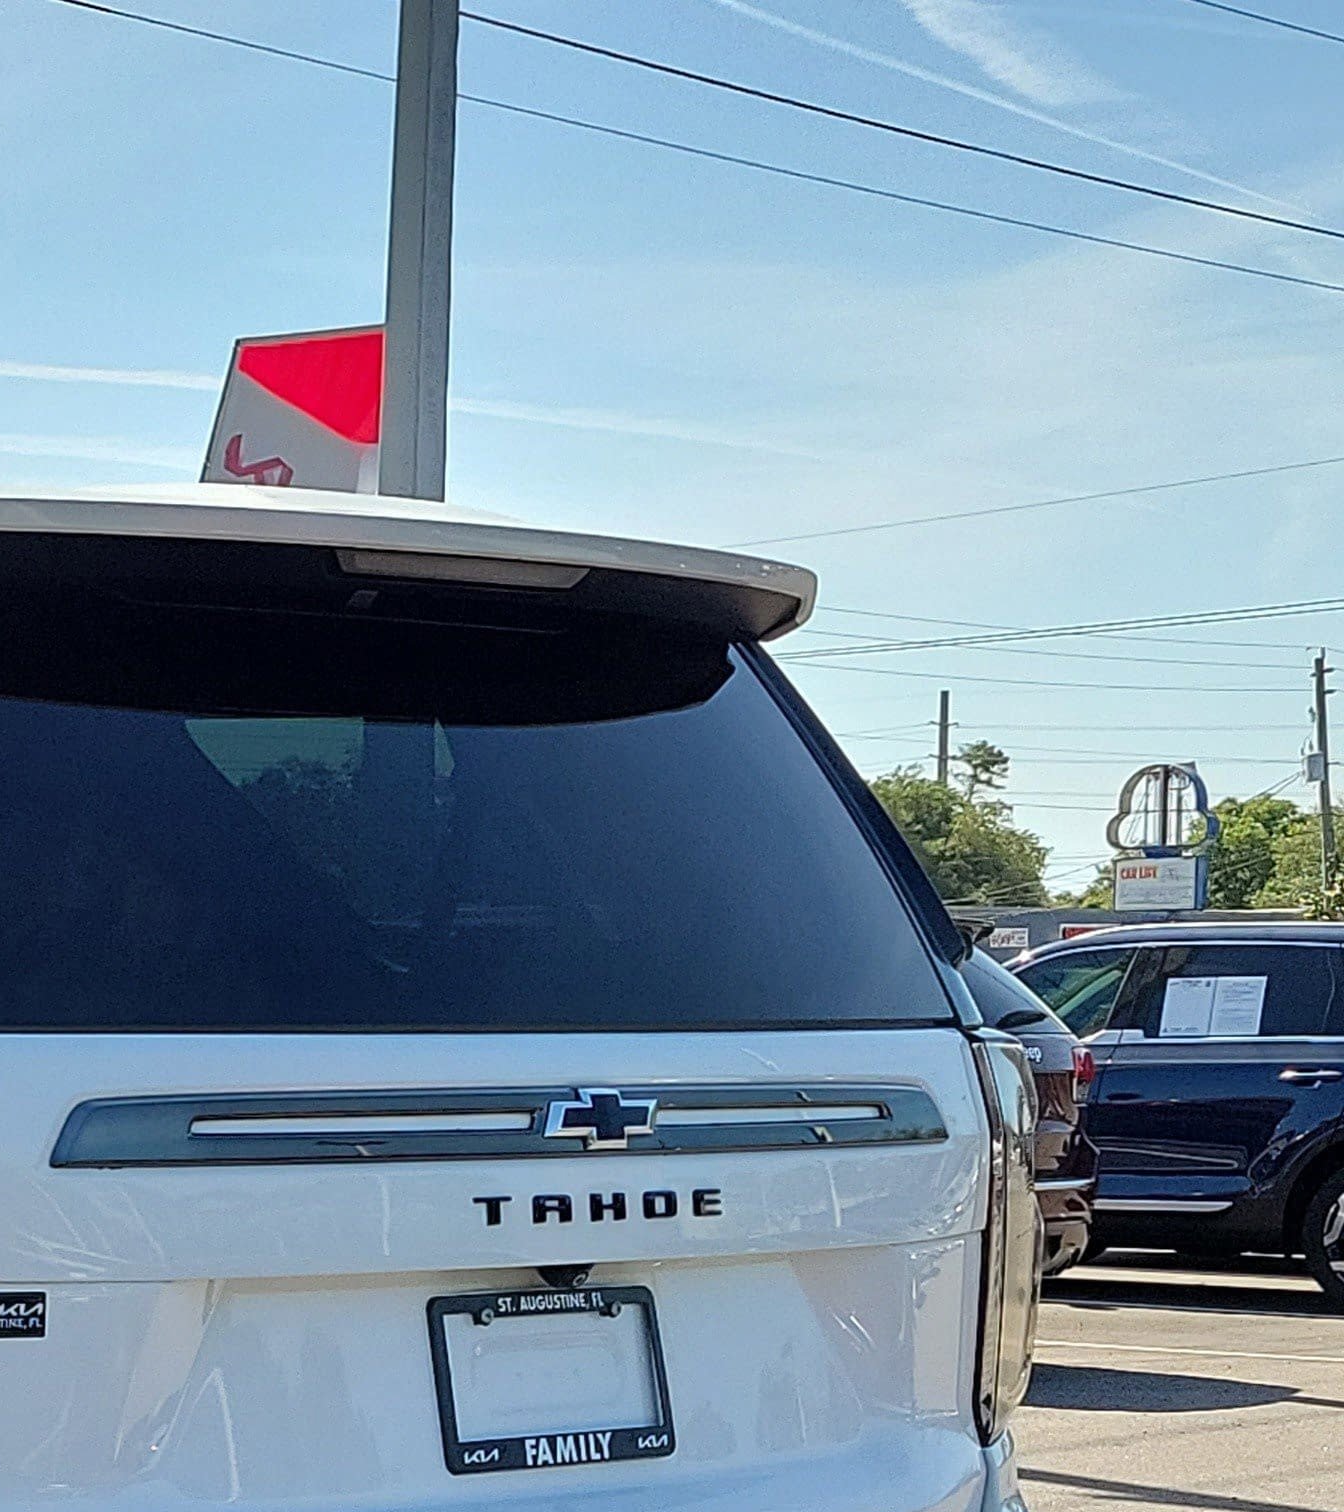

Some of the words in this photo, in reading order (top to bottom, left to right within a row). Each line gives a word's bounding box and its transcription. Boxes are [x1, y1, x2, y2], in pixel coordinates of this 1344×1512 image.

[472, 1189, 723, 1226] TAHOE
[497, 1296, 516, 1312] ST.
[519, 1293, 590, 1311] AUGUSTINE,
[592, 1291, 605, 1307] FL
[28, 1317, 43, 1328] FL
[524, 1431, 613, 1466] FAMILY
